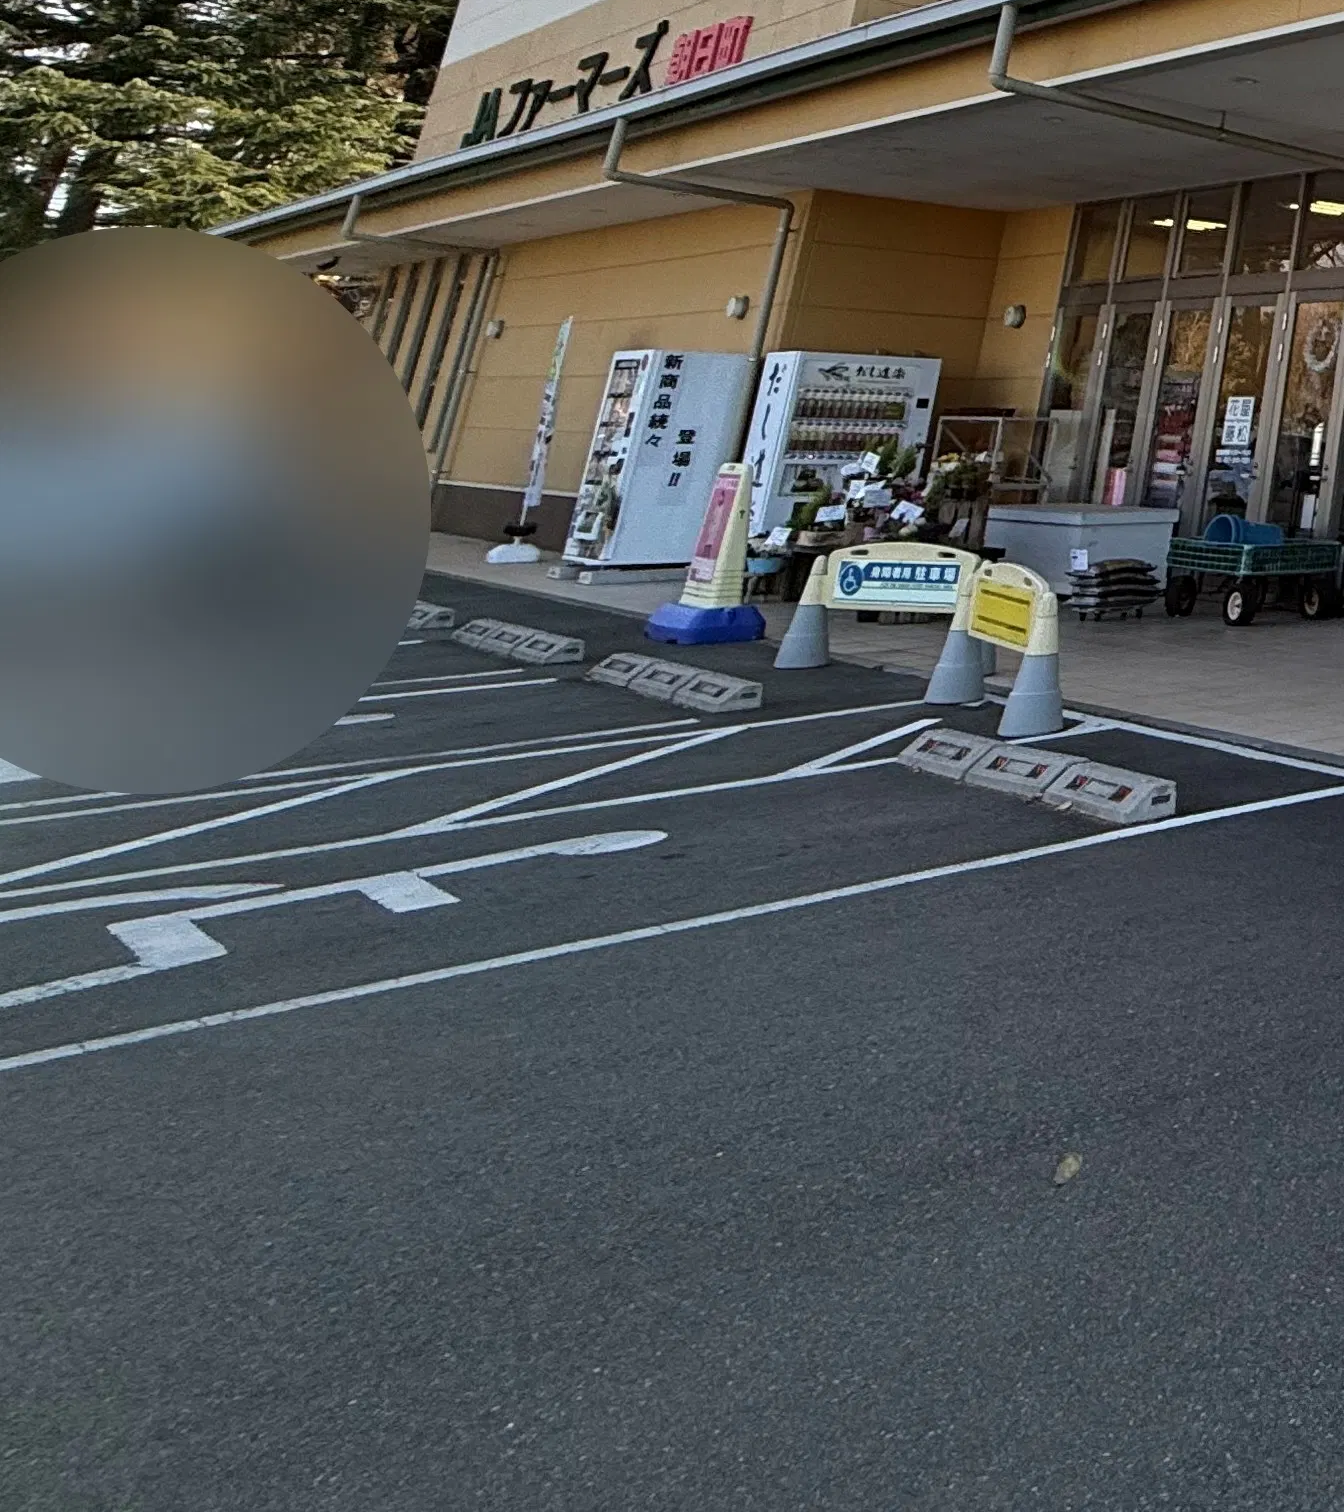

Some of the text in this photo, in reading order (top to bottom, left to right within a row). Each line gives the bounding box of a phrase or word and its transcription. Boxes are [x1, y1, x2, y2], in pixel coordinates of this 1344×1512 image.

[645, 354, 684, 447] 新商品続々
[914, 566, 957, 581] 駐車場
